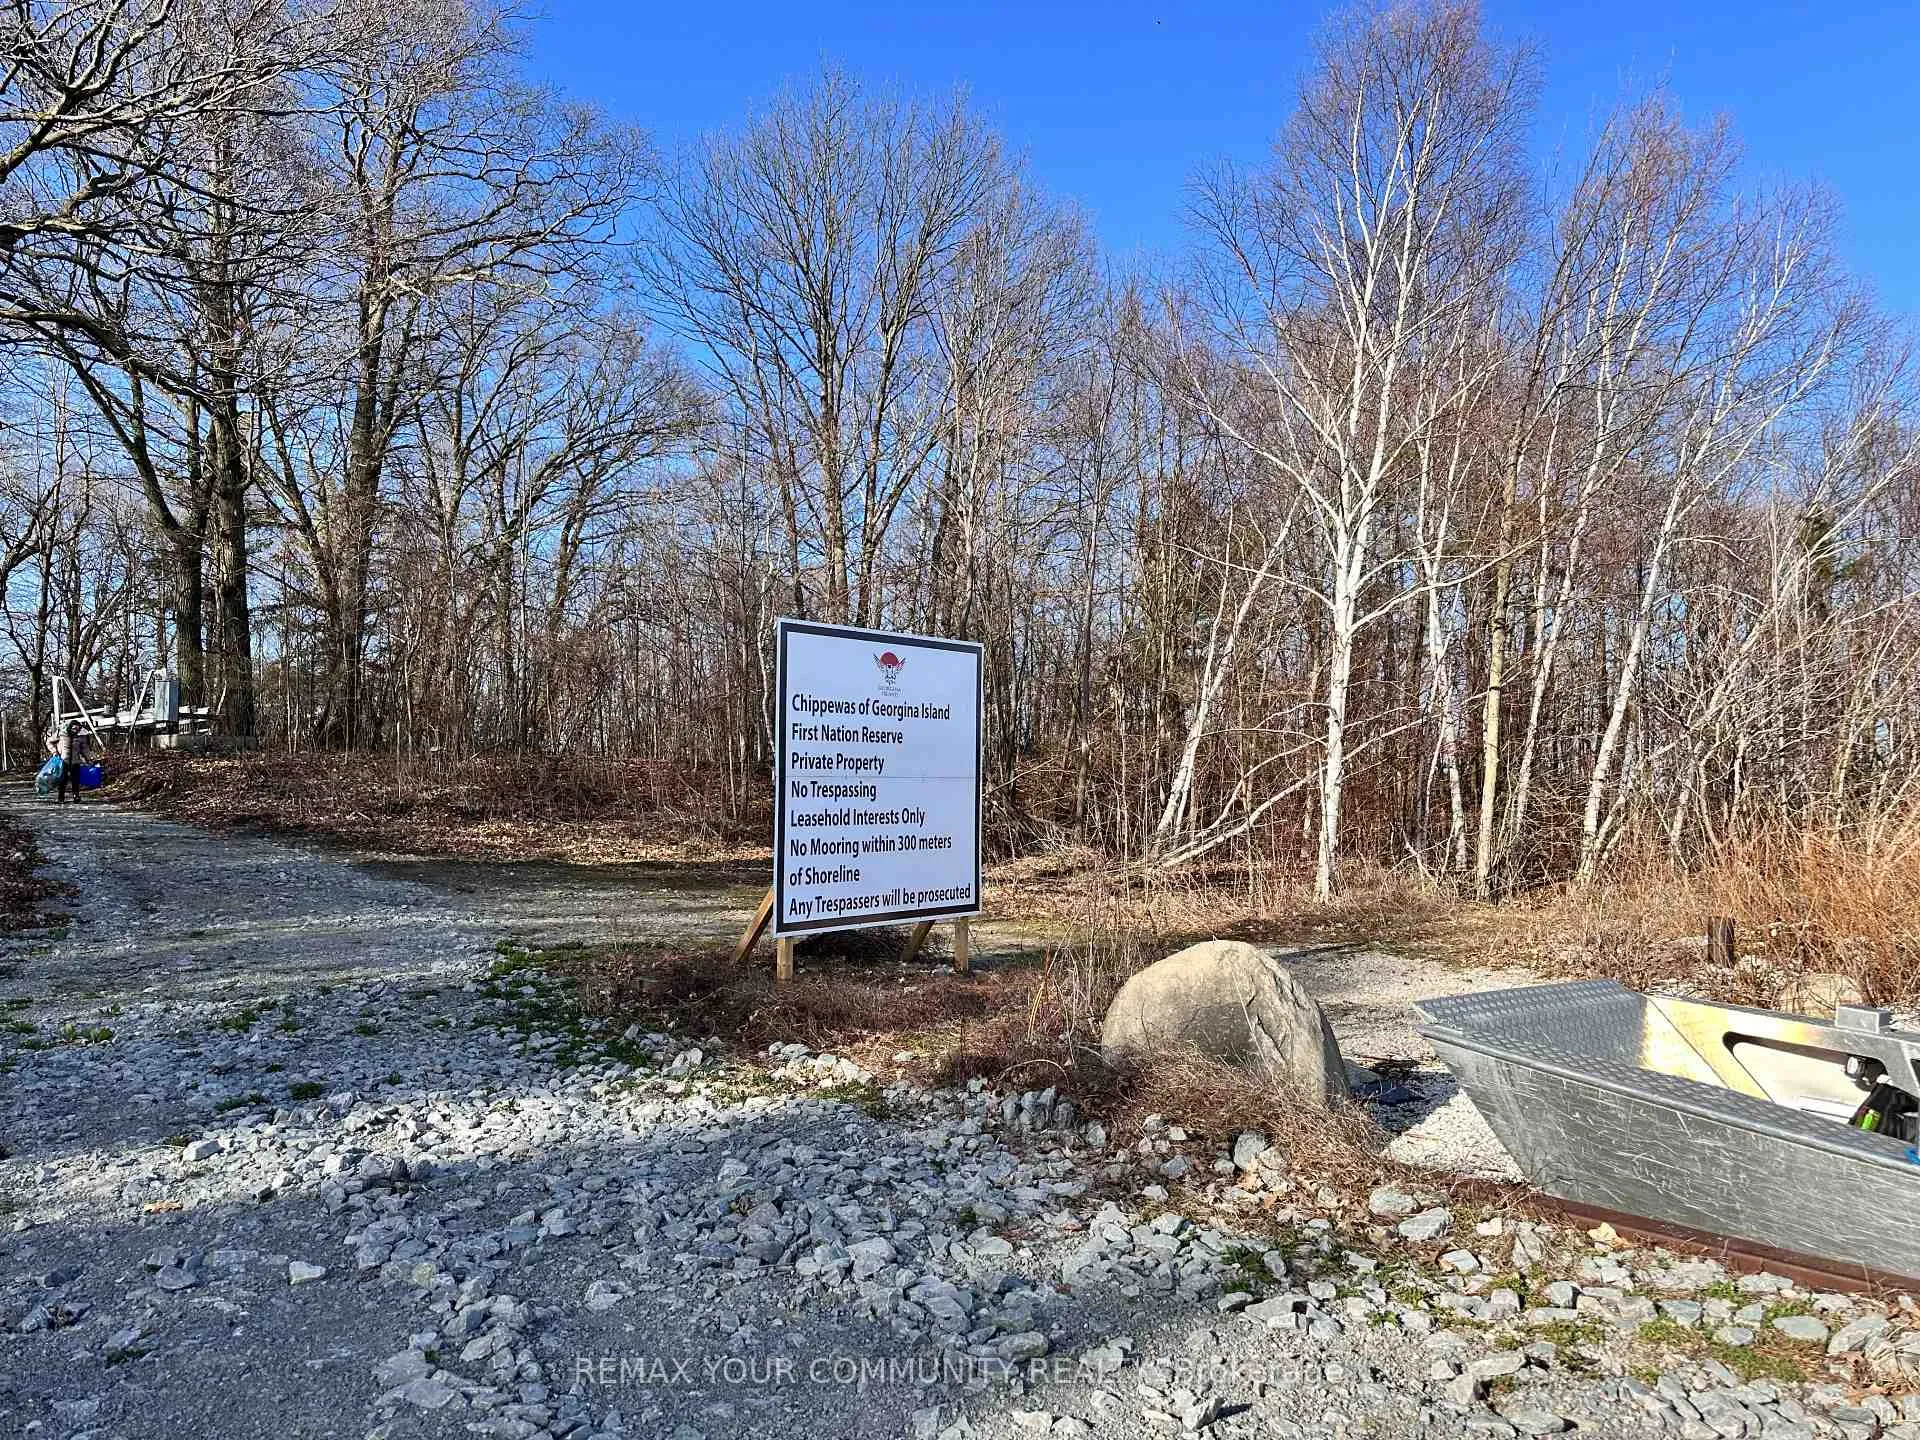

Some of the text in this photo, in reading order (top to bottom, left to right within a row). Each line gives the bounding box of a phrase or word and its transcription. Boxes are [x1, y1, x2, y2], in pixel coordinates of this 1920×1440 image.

[792, 694, 950, 721] Chippewas of Georgina Island
[792, 723, 903, 744] First Nation Reserve
[792, 752, 885, 774] Private Property
[791, 781, 877, 802] No Trespassing
[790, 807, 926, 828] Leasehold Interests Only
[790, 835, 952, 858] No Mooring within 300 meters
[789, 865, 860, 886] of Shoreline
[789, 883, 971, 918] Any Trespassers will be prosecuted
